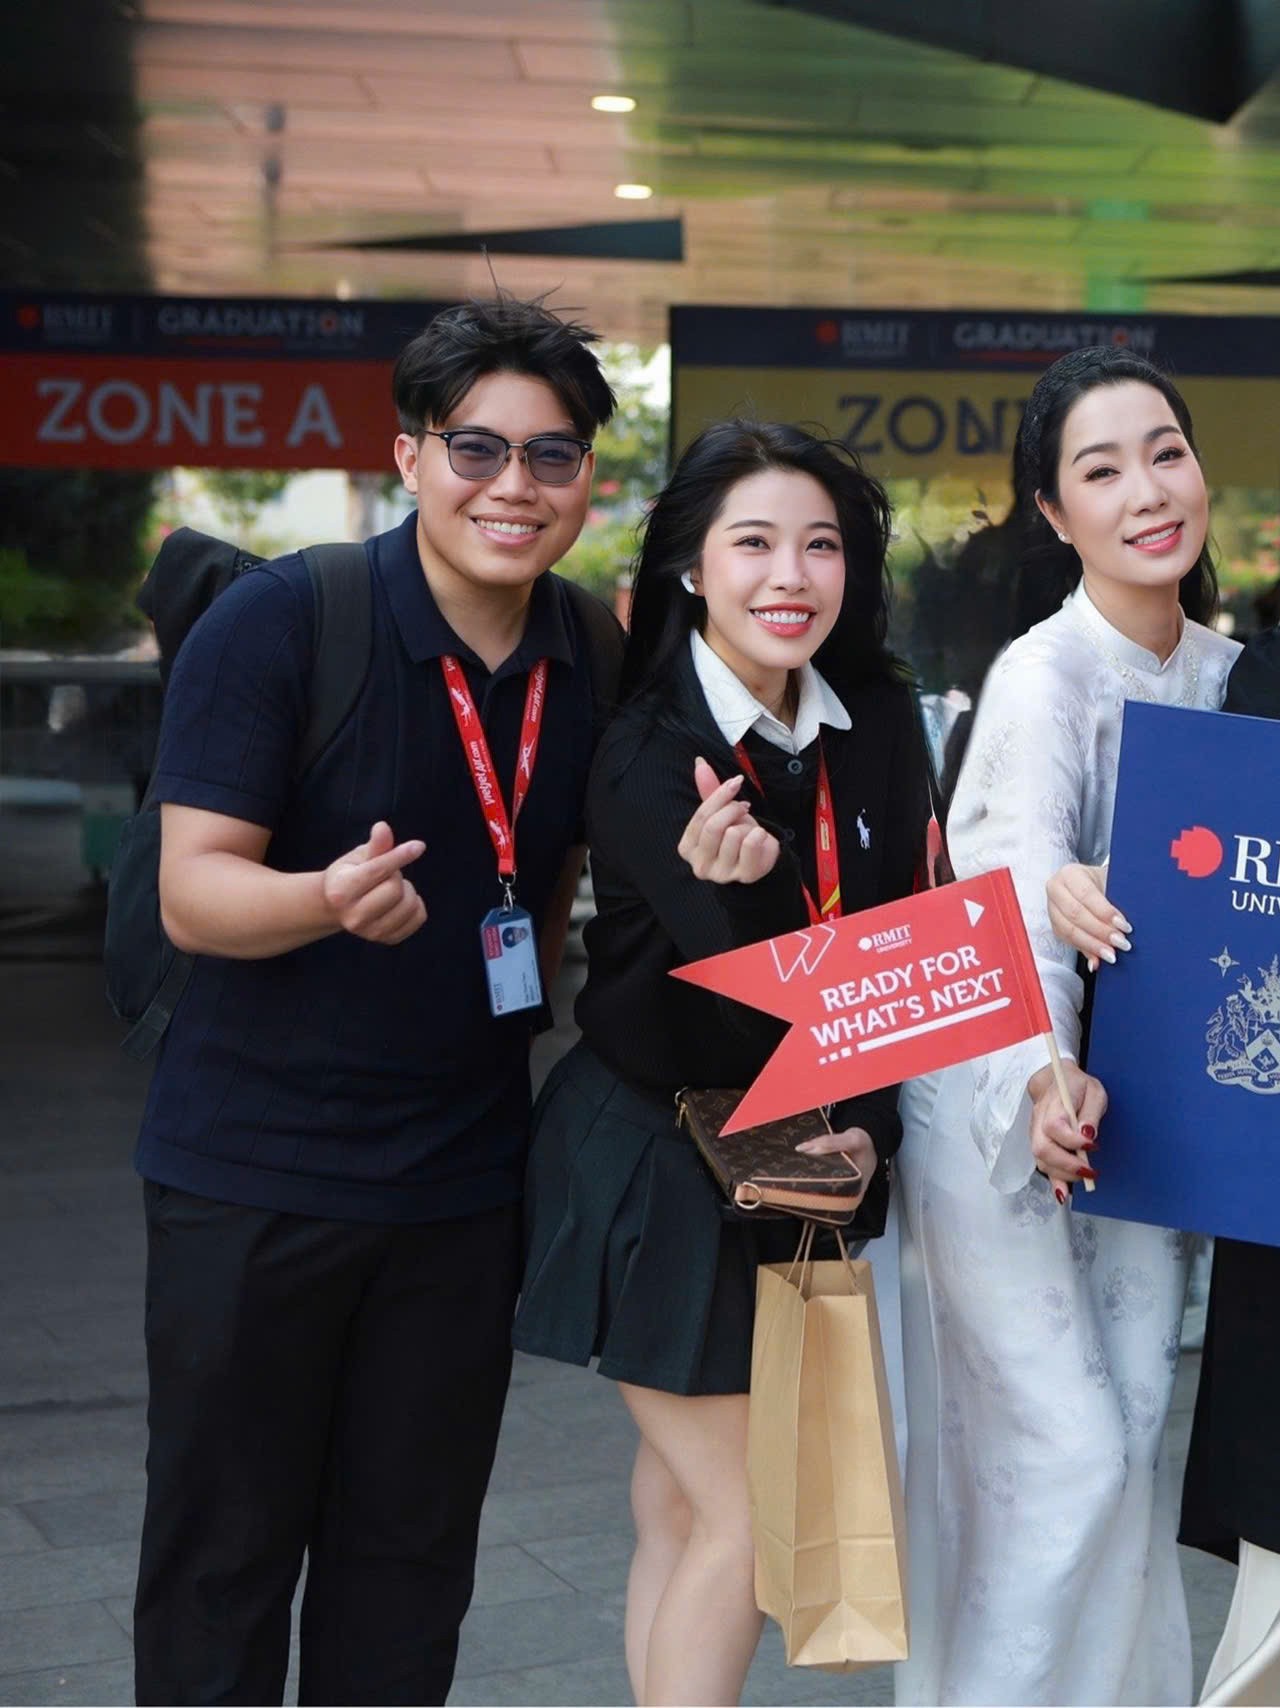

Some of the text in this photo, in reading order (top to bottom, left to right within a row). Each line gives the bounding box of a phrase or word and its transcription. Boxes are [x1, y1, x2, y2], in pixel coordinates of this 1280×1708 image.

[157, 305, 364, 337] GRADUATION
[841, 322, 911, 346] RMIT
[953, 322, 1156, 350] GRADUATION
[36, 379, 343, 448] ZONE A
[838, 392, 1024, 457] ZON
[869, 924, 912, 948] RMIT
[820, 945, 981, 1012] READY FOR
[811, 969, 1004, 1047] WHAT'S NEXT
